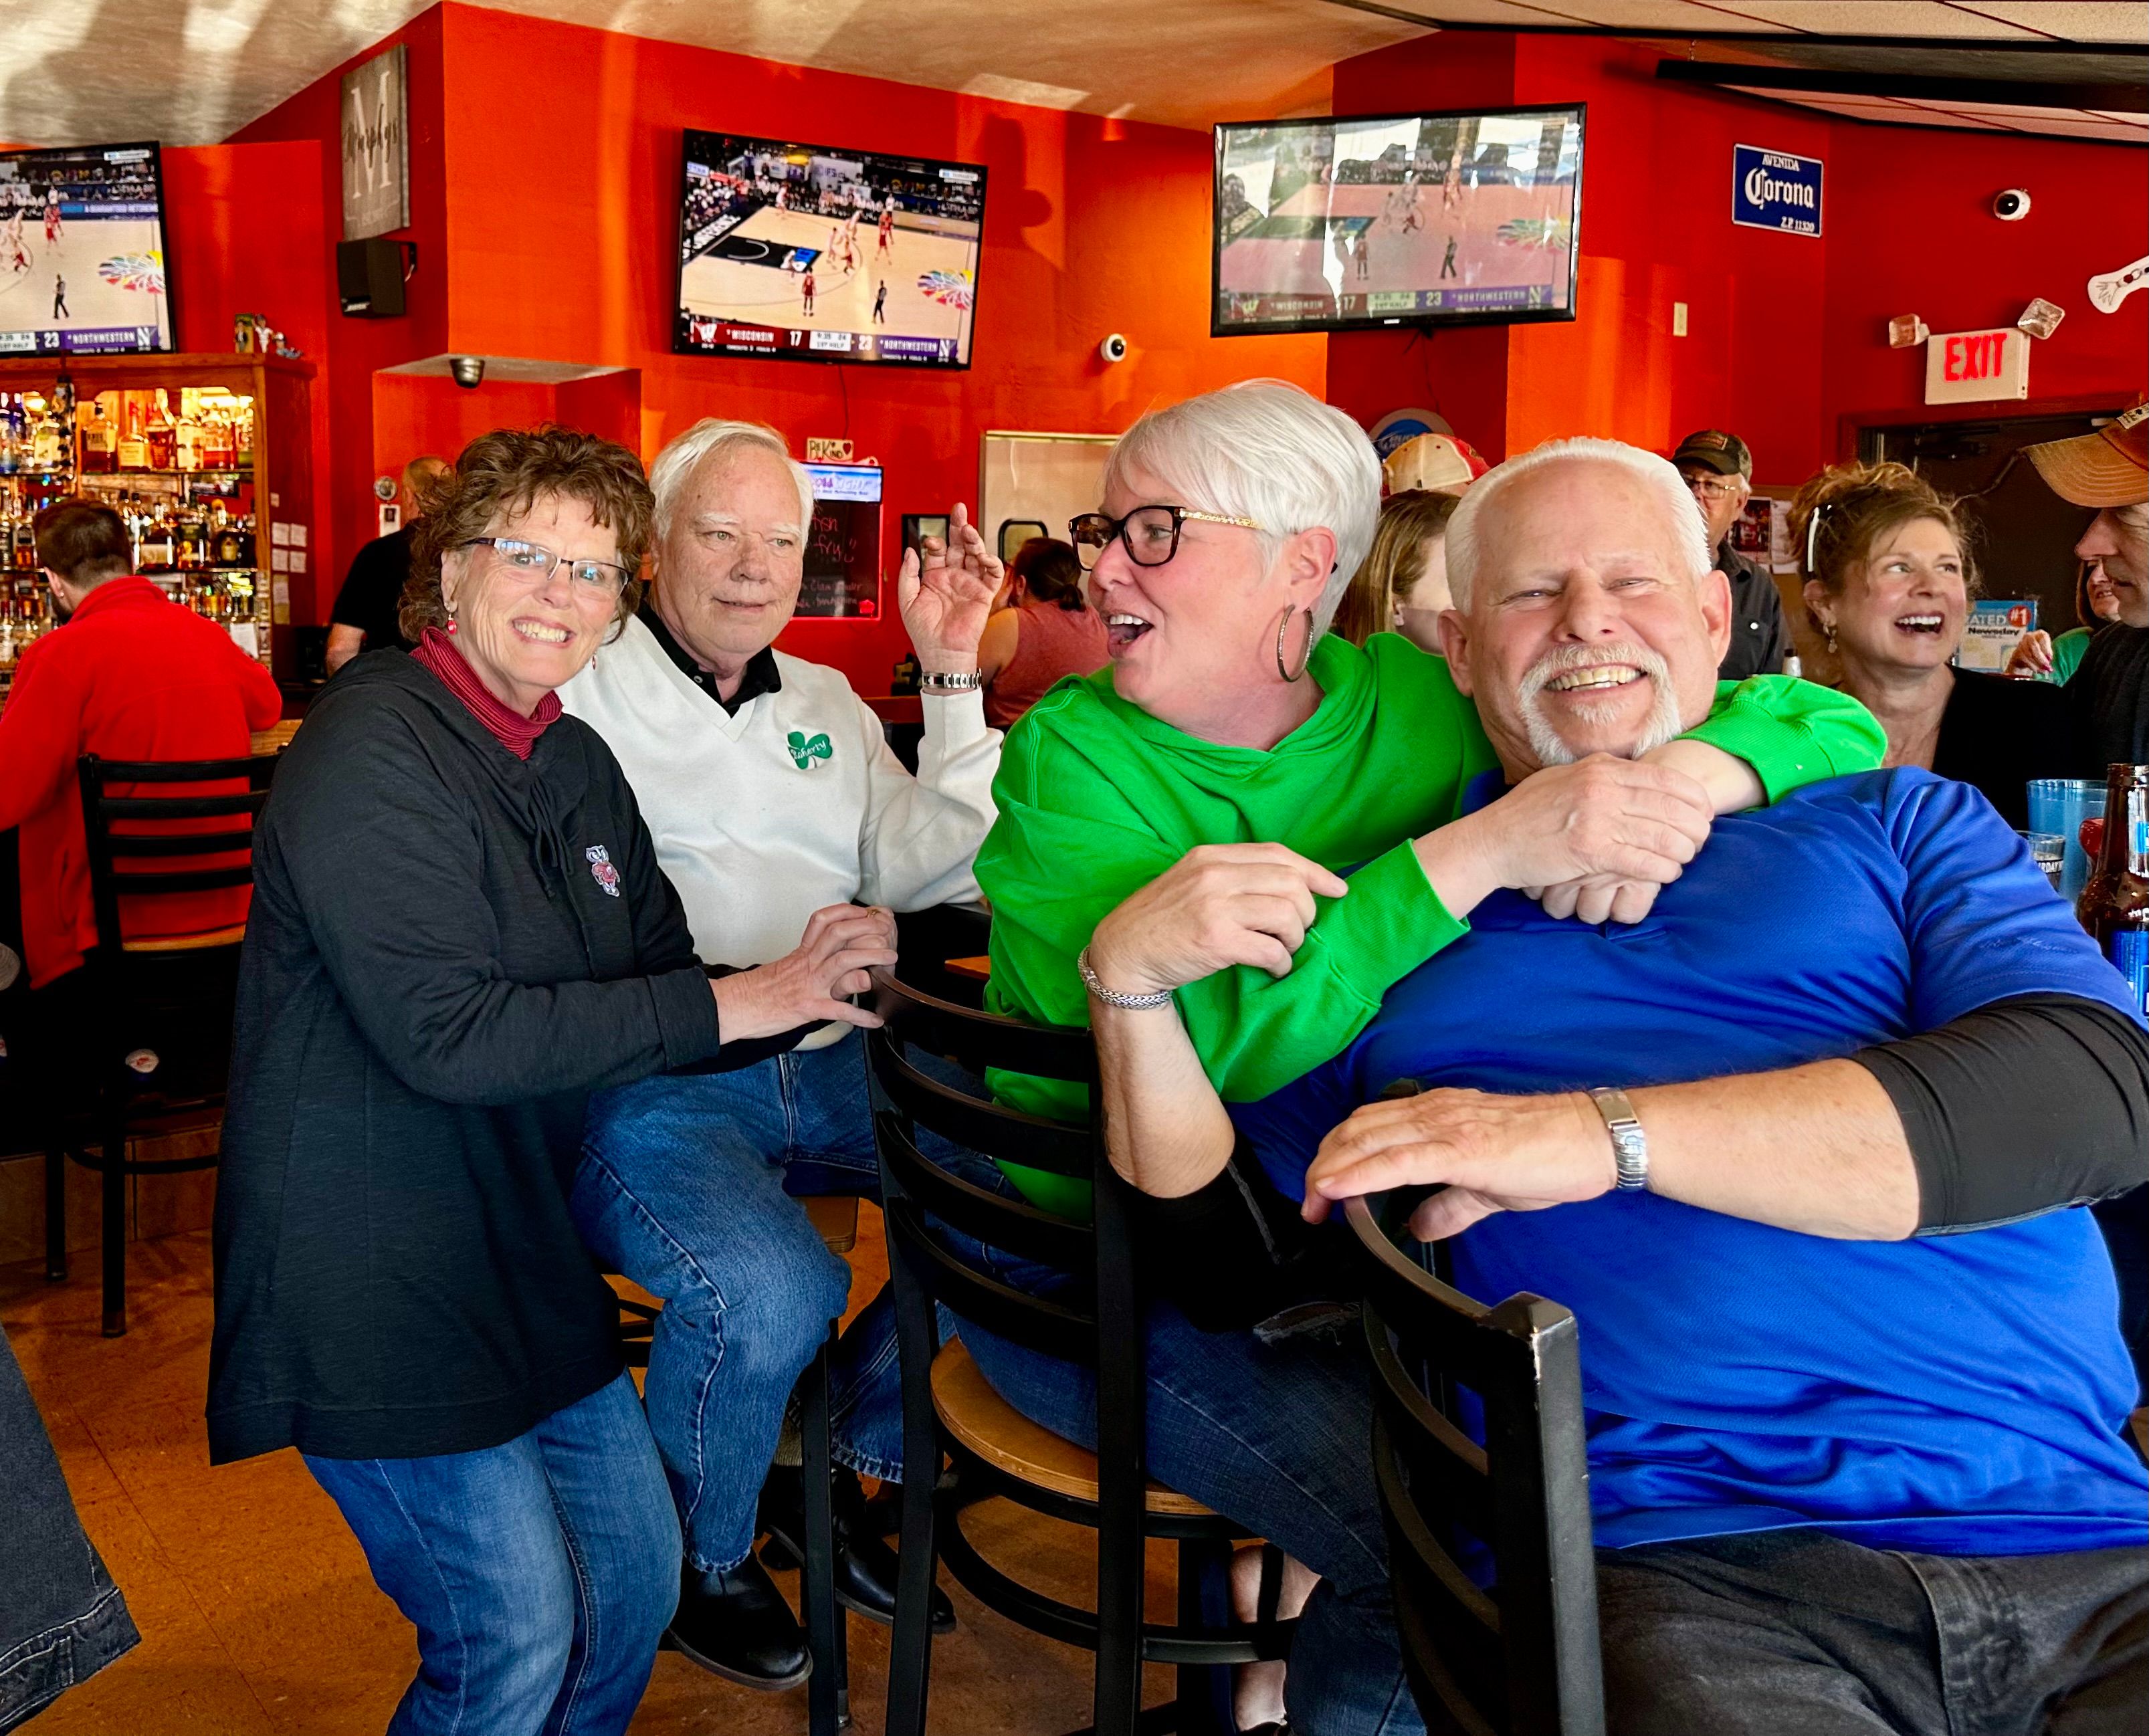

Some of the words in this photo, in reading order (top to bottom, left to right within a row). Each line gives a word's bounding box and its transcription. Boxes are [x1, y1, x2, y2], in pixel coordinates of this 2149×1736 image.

[1762, 154, 1800, 172] AVENIDA
[1744, 167, 1814, 210] Corona
[1275, 301, 1324, 311] WISCONSIN
[1342, 296, 1356, 311] 17
[1426, 292, 1442, 306] 23
[1457, 291, 1526, 302] NORTHWESTERN
[43, 332, 60, 348] 23
[72, 332, 135, 344] NORTHWESTERN
[731, 330, 775, 342] WISCONSIN
[790, 330, 802, 346] 17
[858, 335, 874, 350] 23
[884, 339, 938, 353] NORTHWESTERN
[1944, 332, 2008, 382] EXIT
[1969, 614, 2007, 625] ATED
[2011, 609, 2027, 625] #1
